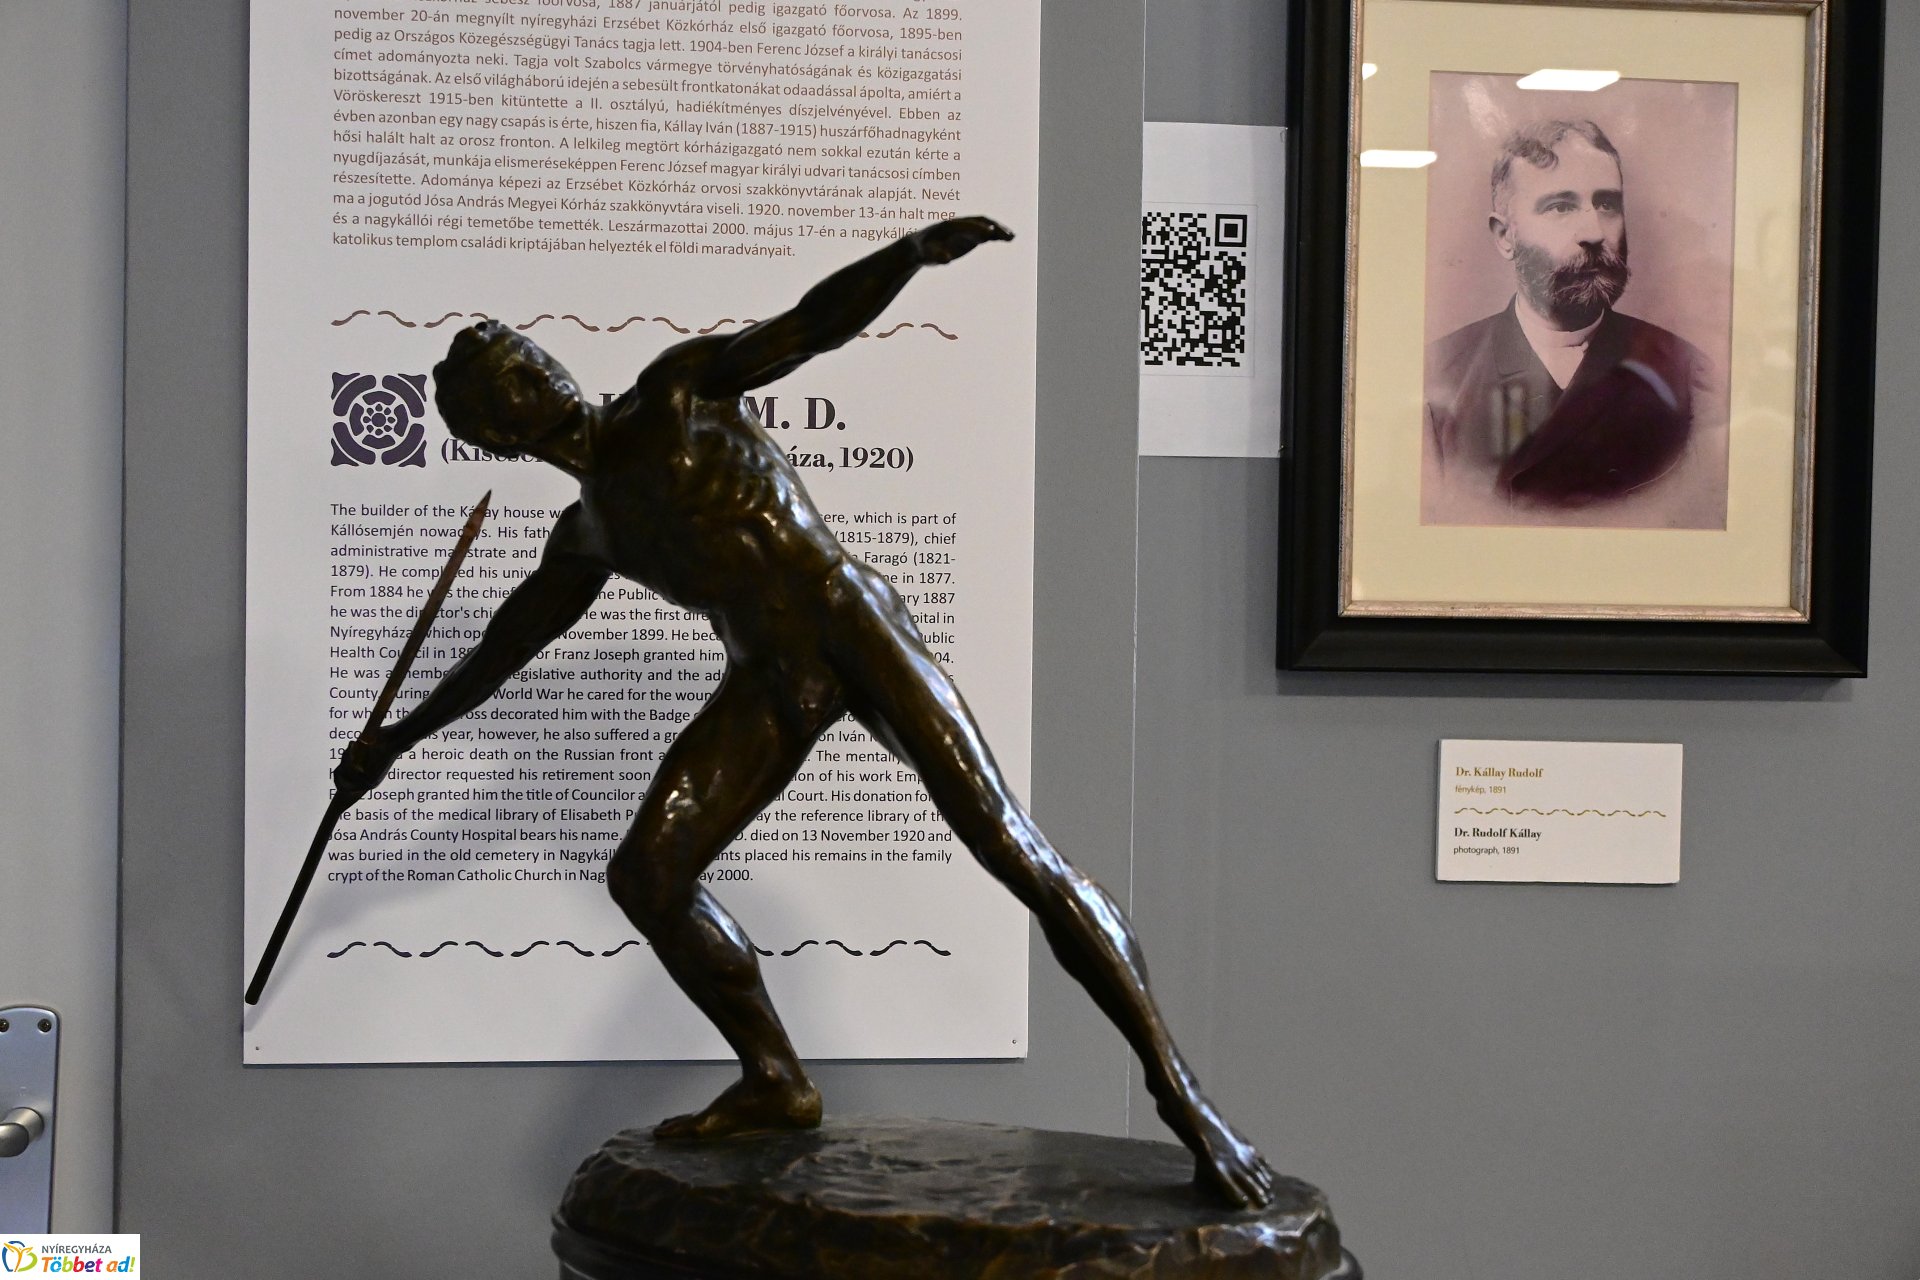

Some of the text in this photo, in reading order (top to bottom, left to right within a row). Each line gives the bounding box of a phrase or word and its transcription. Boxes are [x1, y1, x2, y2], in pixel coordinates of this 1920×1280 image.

[729, 1, 962, 20] pedig igazgató főorvosa. Az 1899.
[335, 8, 961, 40] november 20-án megnyílt nyíregyházi Erzsébet Közkórház első igazgató főorvosa, 1895-ben
[334, 48, 961, 82] címet adományozta neki. Tagja volt Szabolcs vármegye törvényhatóságának és közigazgatási
[334, 89, 961, 120] Vöröskereszt 1915-ben kitüntette a II. osztályú, hadiékítményes díszjelvényével. Ebben az
[334, 152, 960, 180] nyugdíjazását, munkája elismeréseképpen Ferenc József magyar királyi udvari tanácsosi címben
[334, 171, 960, 201] részesítette. Adománya képezi az Erzsébet Közkórház orvosi szakkönyvtárának alapját. Nevét
[333, 232, 795, 258] katolikus templom családi kriptájában helyezték el földi maradványait.
[744, 396, 846, 430] M. D.
[838, 446, 914, 472] 1920)
[330, 504, 957, 527] The builder of the house which is part of
[332, 524, 956, 547] Kállósemjén His (1815-1879), chief
[331, 544, 955, 566] administrative and Faragó (1821-
[331, 565, 955, 584] 1879). He his in 1877.
[331, 646, 723, 664] Health in Franz Joseph granted him
[442, 728, 865, 742] year, however, he also suffered a Iván
[387, 768, 892, 783] director requested his retirement soon of his work
[1456, 767, 1543, 780] Dr. Kállay Rudolf
[1455, 785, 1486, 794] fénykép,
[356, 808, 927, 824] basis of the medical library of Elisabeth the reference library of
[1454, 828, 1542, 841] Dr. Rudolf Kállay
[328, 849, 952, 864] was buried in the old cemetery in placed his remains in the family
[1453, 846, 1520, 855] photograph, 1891
[328, 869, 753, 884] crypt of the Roman Catholic Church in 2000.
